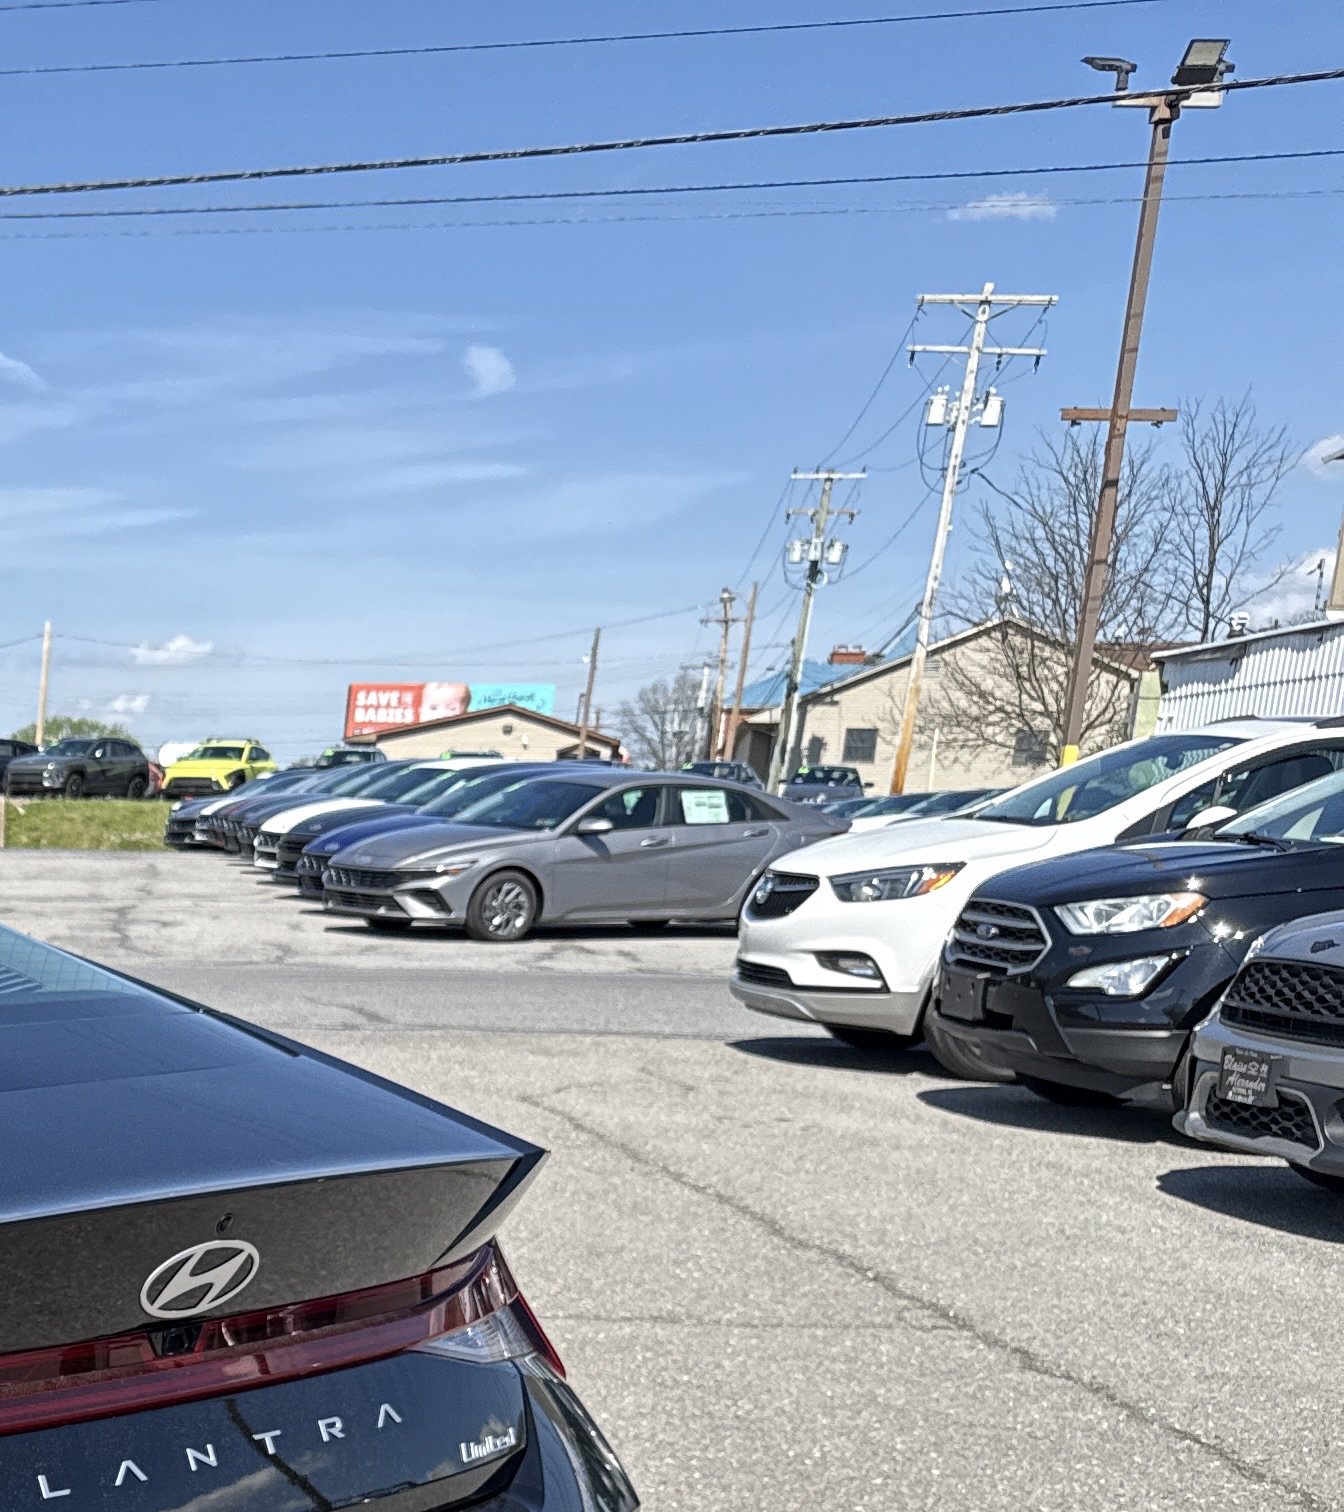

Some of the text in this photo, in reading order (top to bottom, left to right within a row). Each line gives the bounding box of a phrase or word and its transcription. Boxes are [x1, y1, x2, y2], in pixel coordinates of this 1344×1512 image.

[355, 689, 400, 707] SAVE
[353, 707, 415, 724] BABIES
[458, 1426, 517, 1463] Limited
